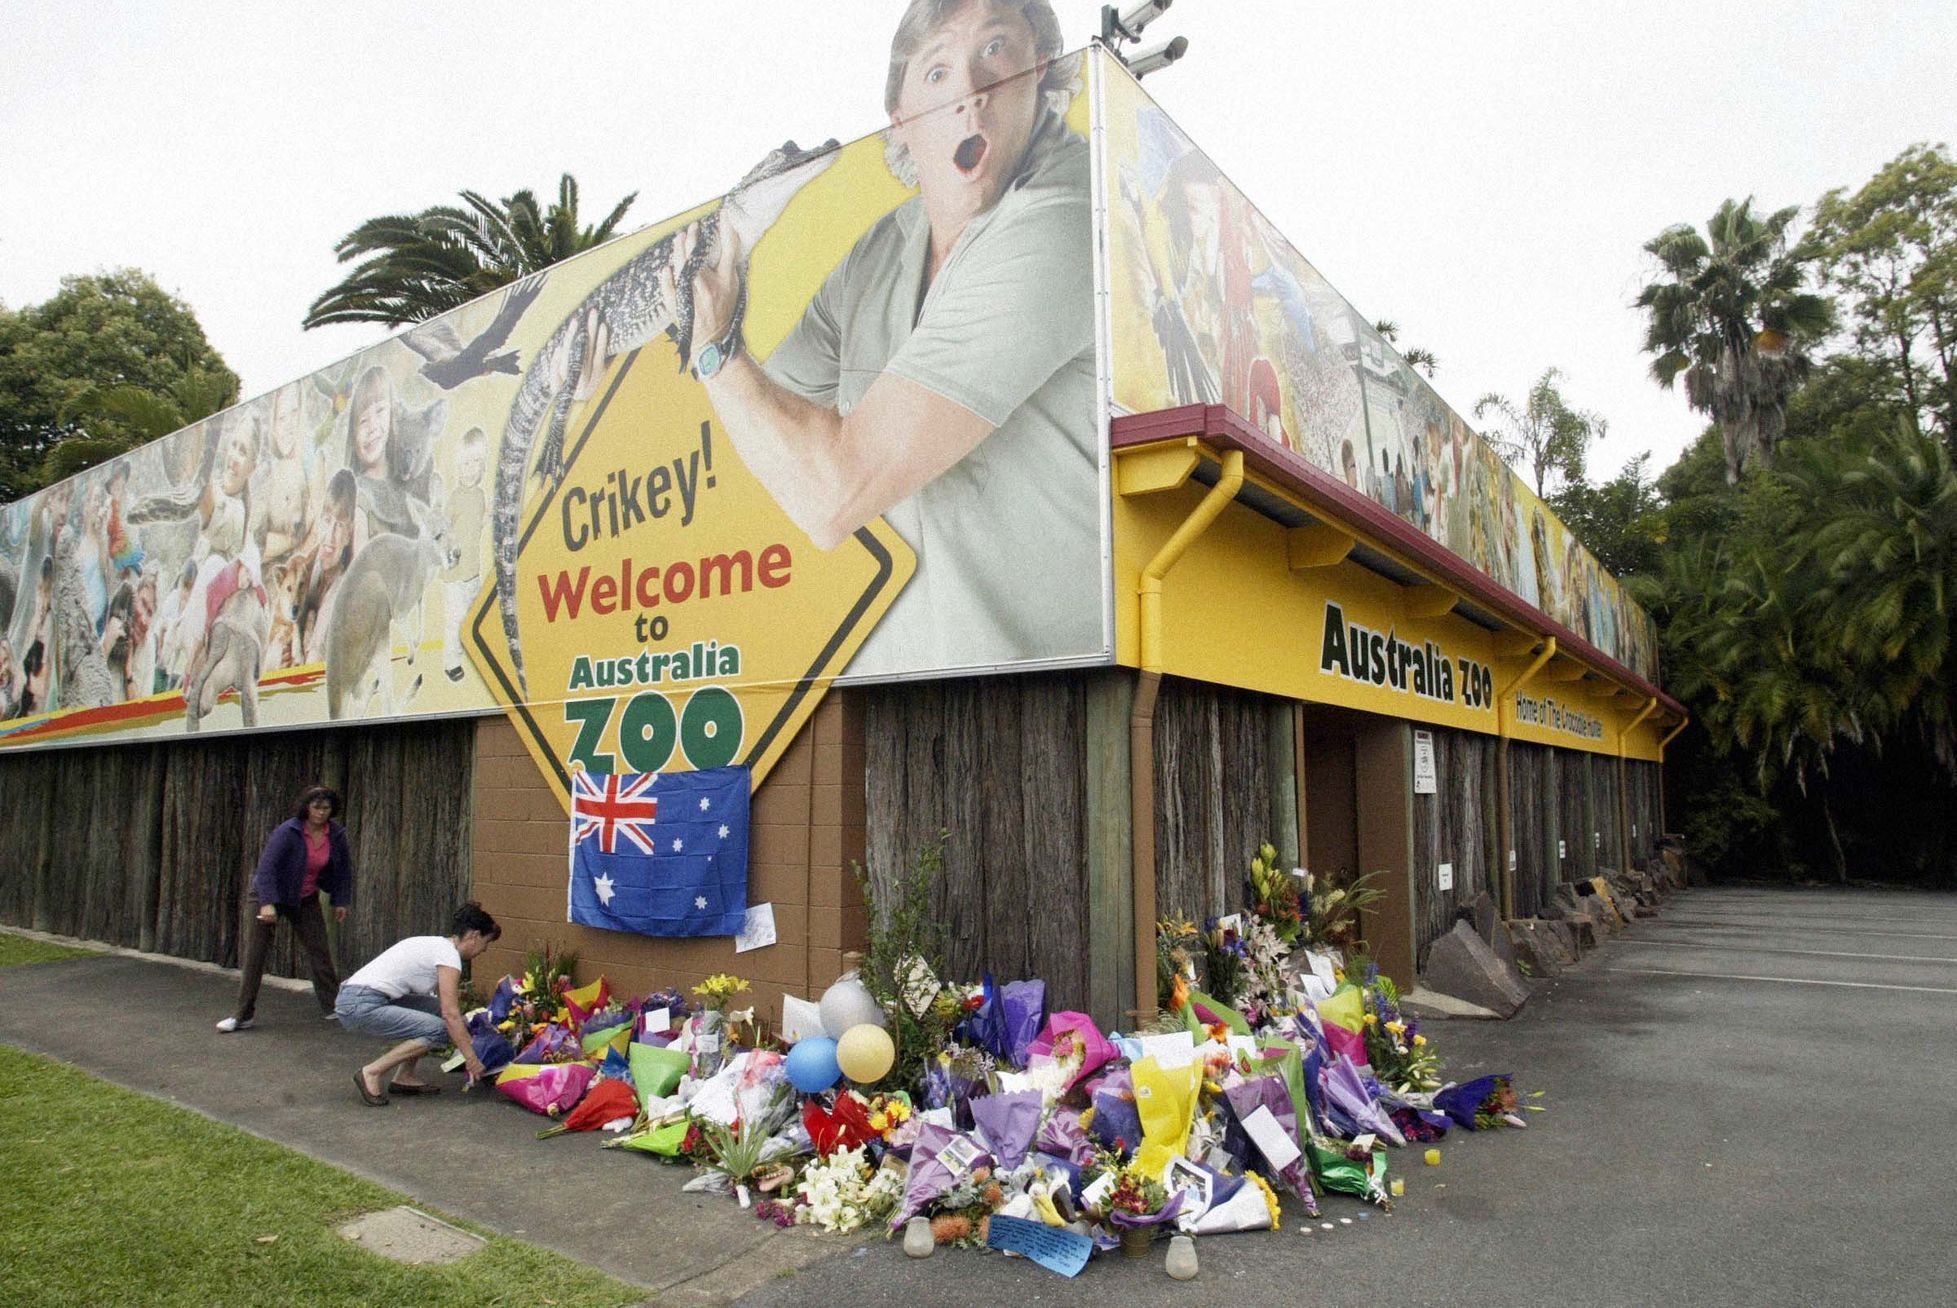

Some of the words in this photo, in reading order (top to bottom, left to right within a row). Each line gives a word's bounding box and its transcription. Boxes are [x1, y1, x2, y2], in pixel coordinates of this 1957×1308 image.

[562, 420, 717, 552] Crikey!
[537, 542, 793, 624] Welcome
[568, 640, 741, 691] Australia
[634, 611, 669, 643] to
[1320, 600, 1455, 704] Australia
[564, 685, 745, 776] ZOO
[1515, 688, 1538, 724] Home
[1547, 699, 1561, 730] The
